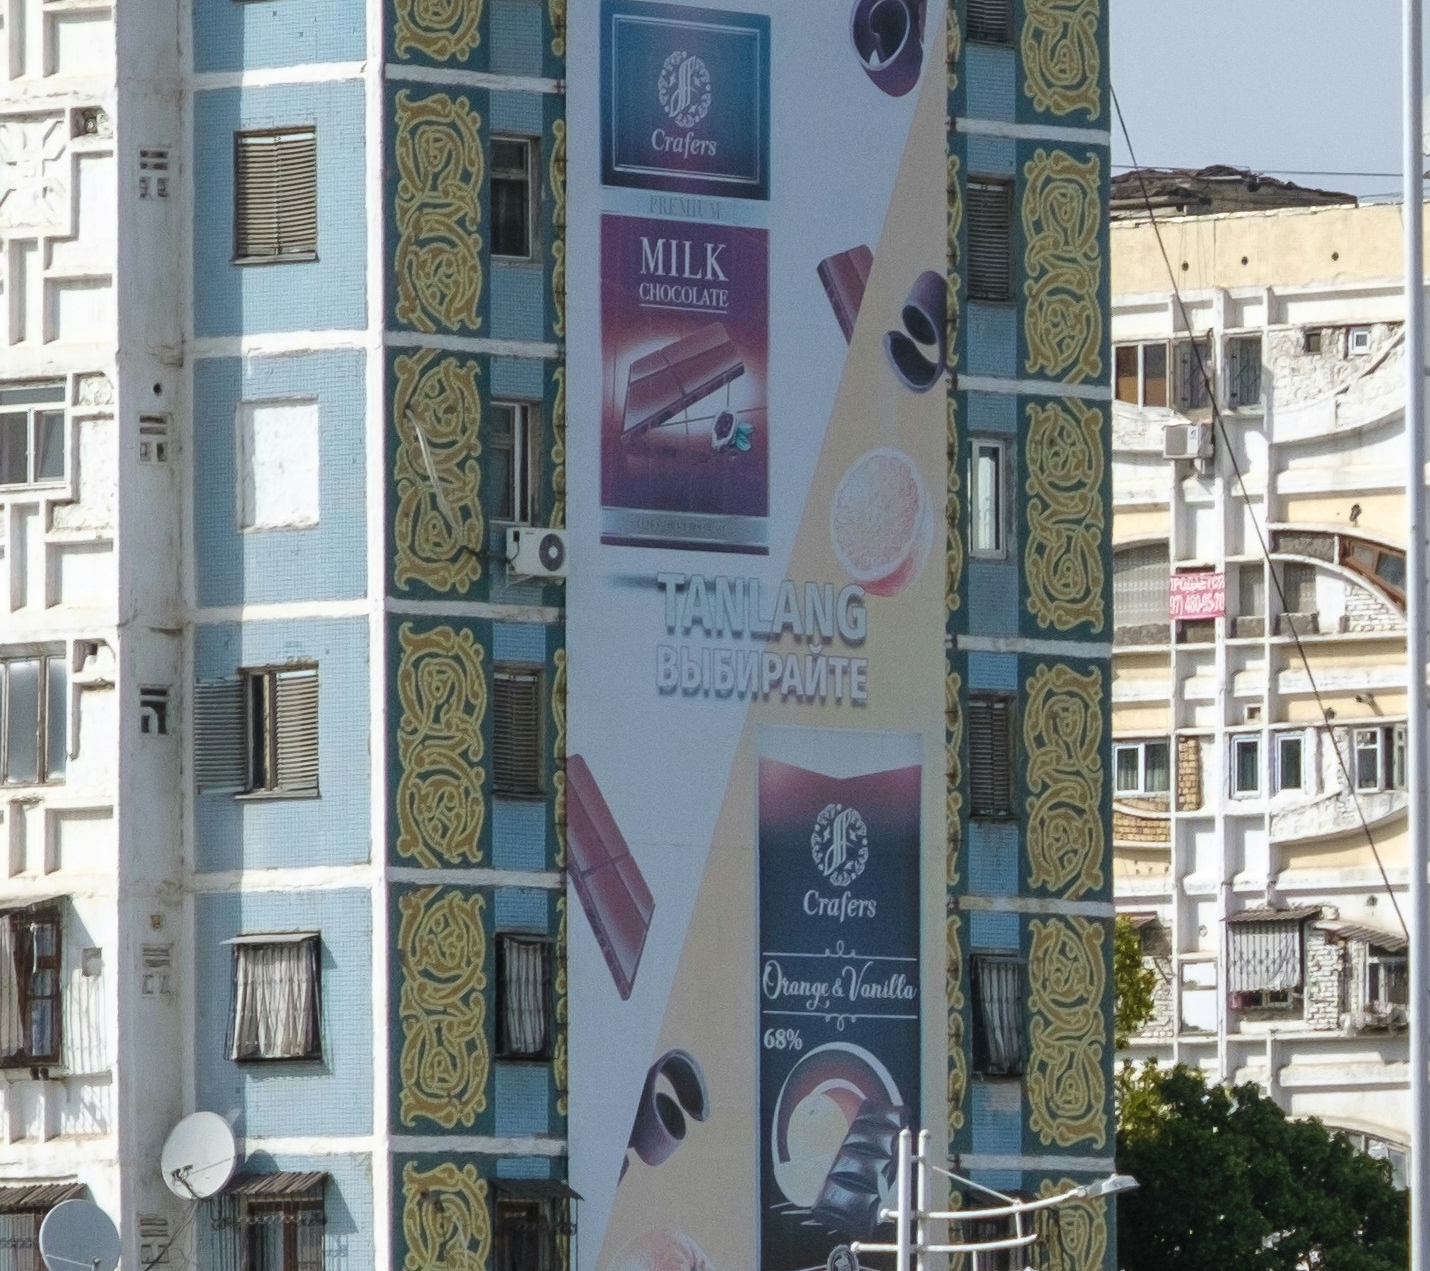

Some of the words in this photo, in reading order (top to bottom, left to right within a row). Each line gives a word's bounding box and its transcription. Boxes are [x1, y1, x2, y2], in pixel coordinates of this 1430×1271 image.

[651, 128, 718, 159] Crafers
[650, 195, 722, 220] PREMIUM
[640, 236, 729, 281] MILK
[639, 283, 729, 307] CHOCOLATE
[657, 572, 868, 643] TANLANG
[656, 643, 868, 702] ВЫБИРАЙТЕ
[803, 890, 877, 923] Crafers
[763, 960, 830, 1010] Orange
[832, 978, 844, 997] &
[842, 961, 918, 1001] Vanilla
[763, 1028, 803, 1050] 68%
